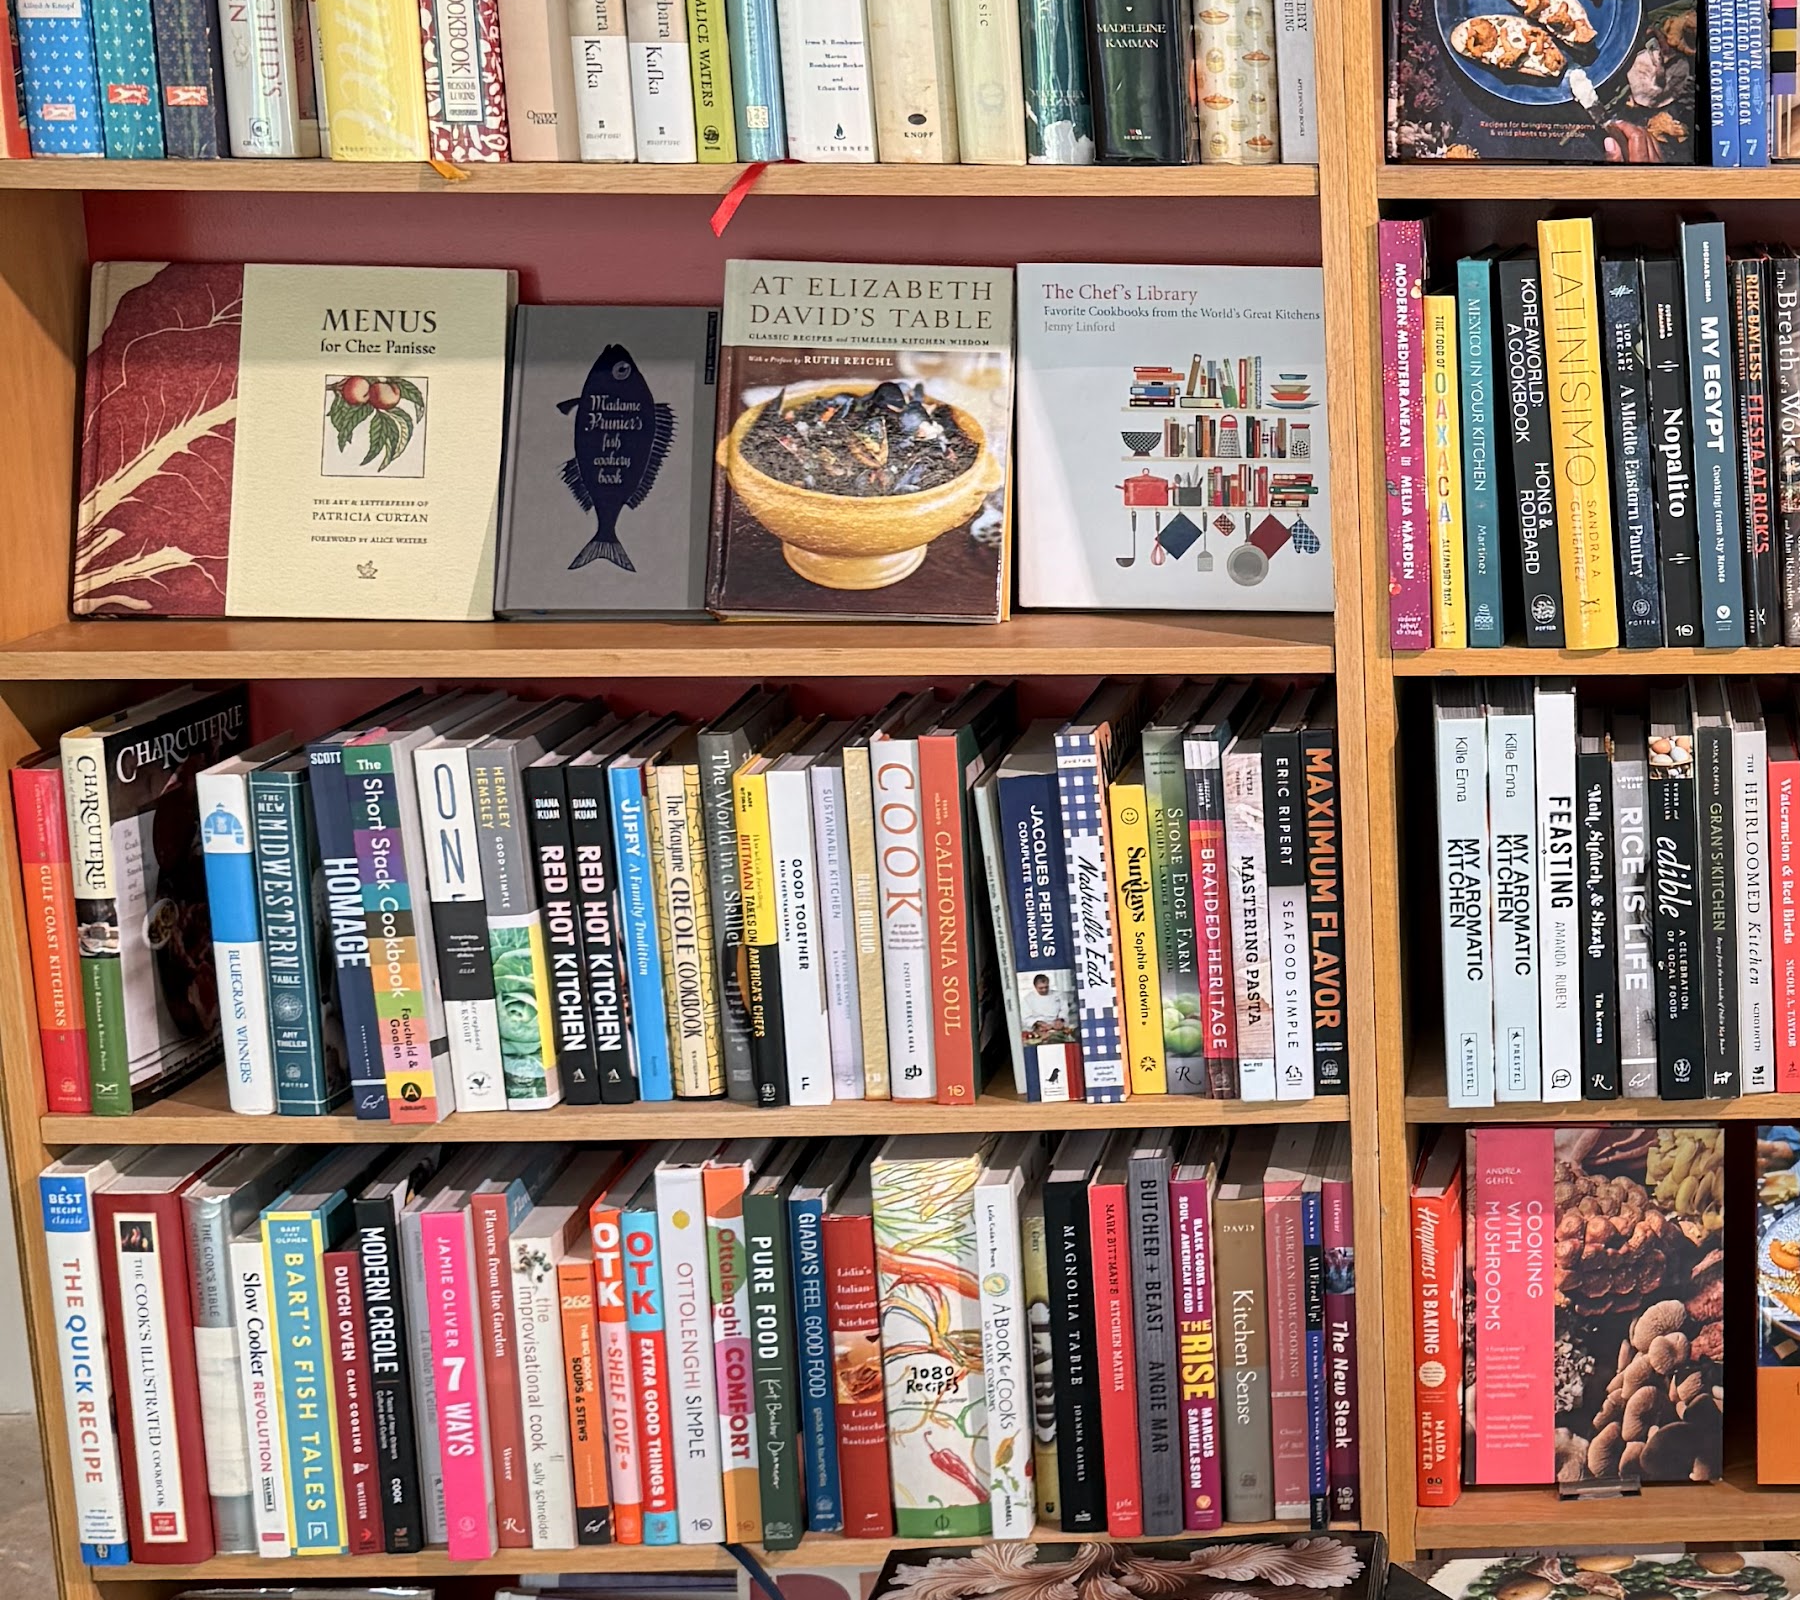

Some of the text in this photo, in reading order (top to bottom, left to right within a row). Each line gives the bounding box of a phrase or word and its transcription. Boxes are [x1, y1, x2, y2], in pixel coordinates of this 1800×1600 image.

[321, 308, 438, 333] MENUS
[750, 304, 992, 330] DAVID'S TABLE
[751, 276, 993, 301] AT ELIZABETH
[1042, 284, 1198, 305] The Chef's Library
[320, 337, 436, 355] for Chez Panisse
[1700, 316, 1725, 453] MY EGYPT
[1659, 406, 1689, 519] Nopalito
[75, 754, 107, 890] CHARCUTERIE
[875, 761, 922, 920] COOK
[1547, 794, 1574, 910] FEASTING
[1655, 835, 1680, 919] edible
[323, 856, 371, 969] HOMAGE
[1303, 747, 1342, 1029] MAXIMUM FLAVOR
[1139, 1178, 1159, 1262] BUTCHER
[242, 1272, 268, 1378] Slow Cooker
[360, 1226, 399, 1374] MODERN CREOLE
[1231, 1288, 1257, 1426] Kitchen Sense
